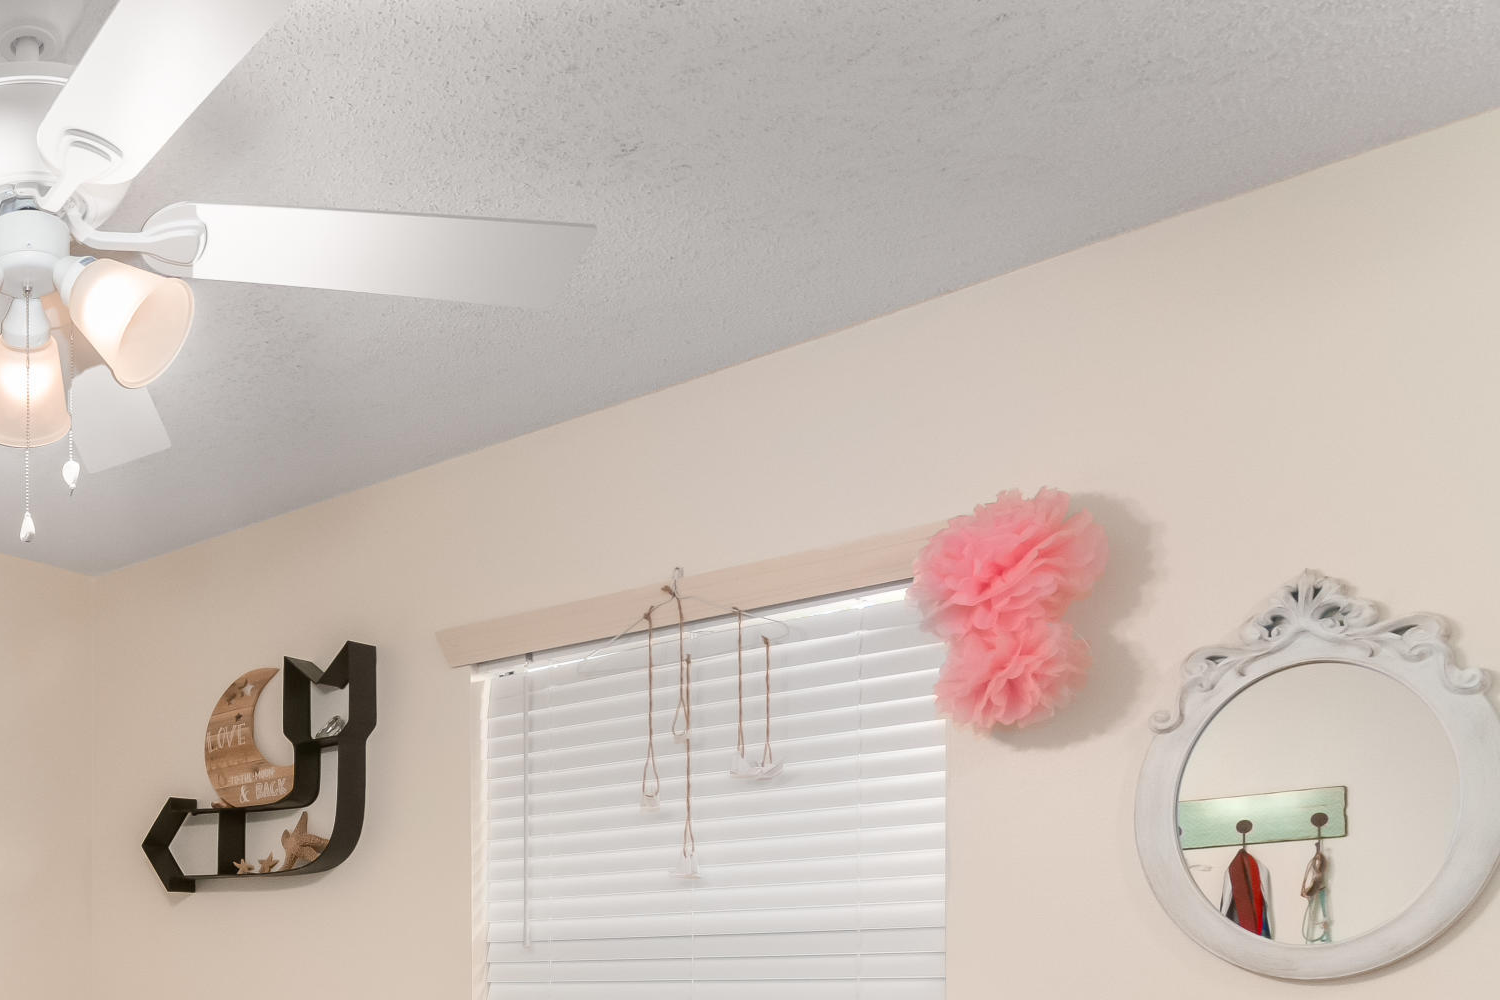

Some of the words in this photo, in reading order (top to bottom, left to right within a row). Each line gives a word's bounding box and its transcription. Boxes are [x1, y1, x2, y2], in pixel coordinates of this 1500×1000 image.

[207, 722, 246, 752] LOVE
[240, 784, 250, 803] &
[255, 777, 287, 800] BACK
